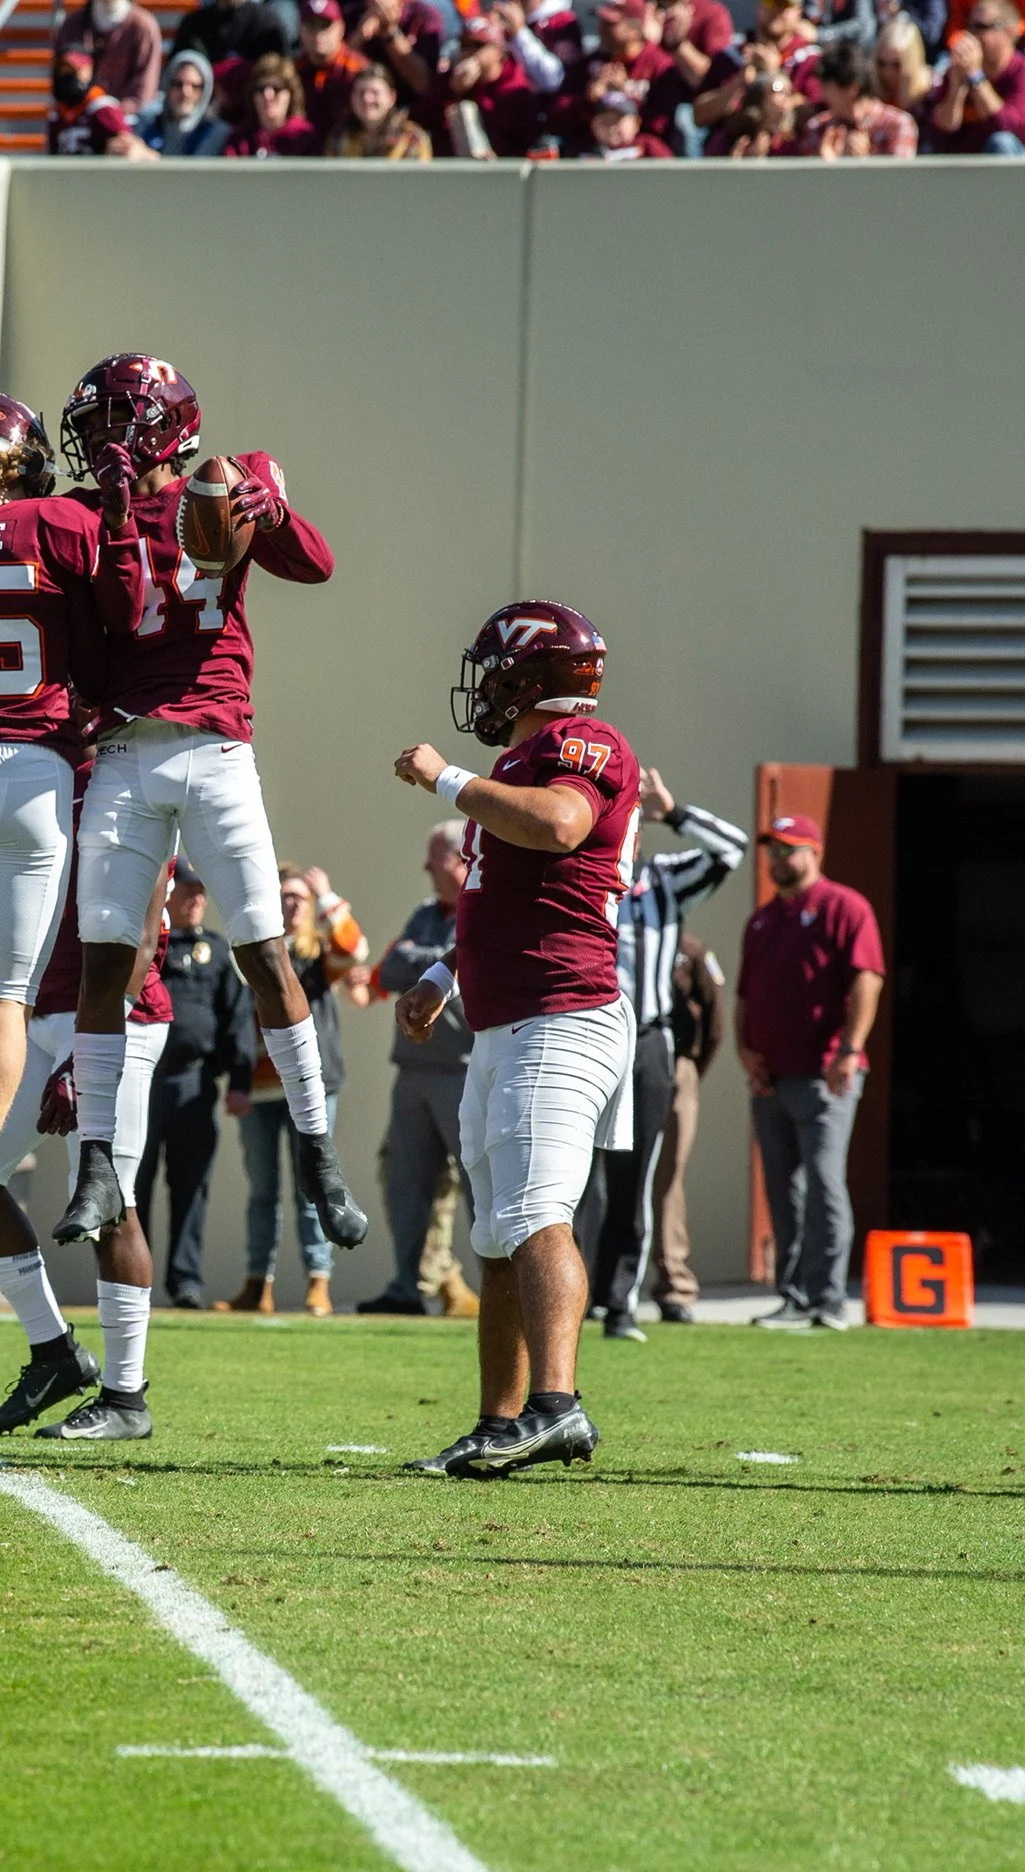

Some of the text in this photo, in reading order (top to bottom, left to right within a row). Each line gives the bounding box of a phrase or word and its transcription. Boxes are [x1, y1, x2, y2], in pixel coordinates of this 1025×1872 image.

[496, 616, 558, 651] VT
[558, 737, 611, 781] 97
[892, 1246, 945, 1315] G
